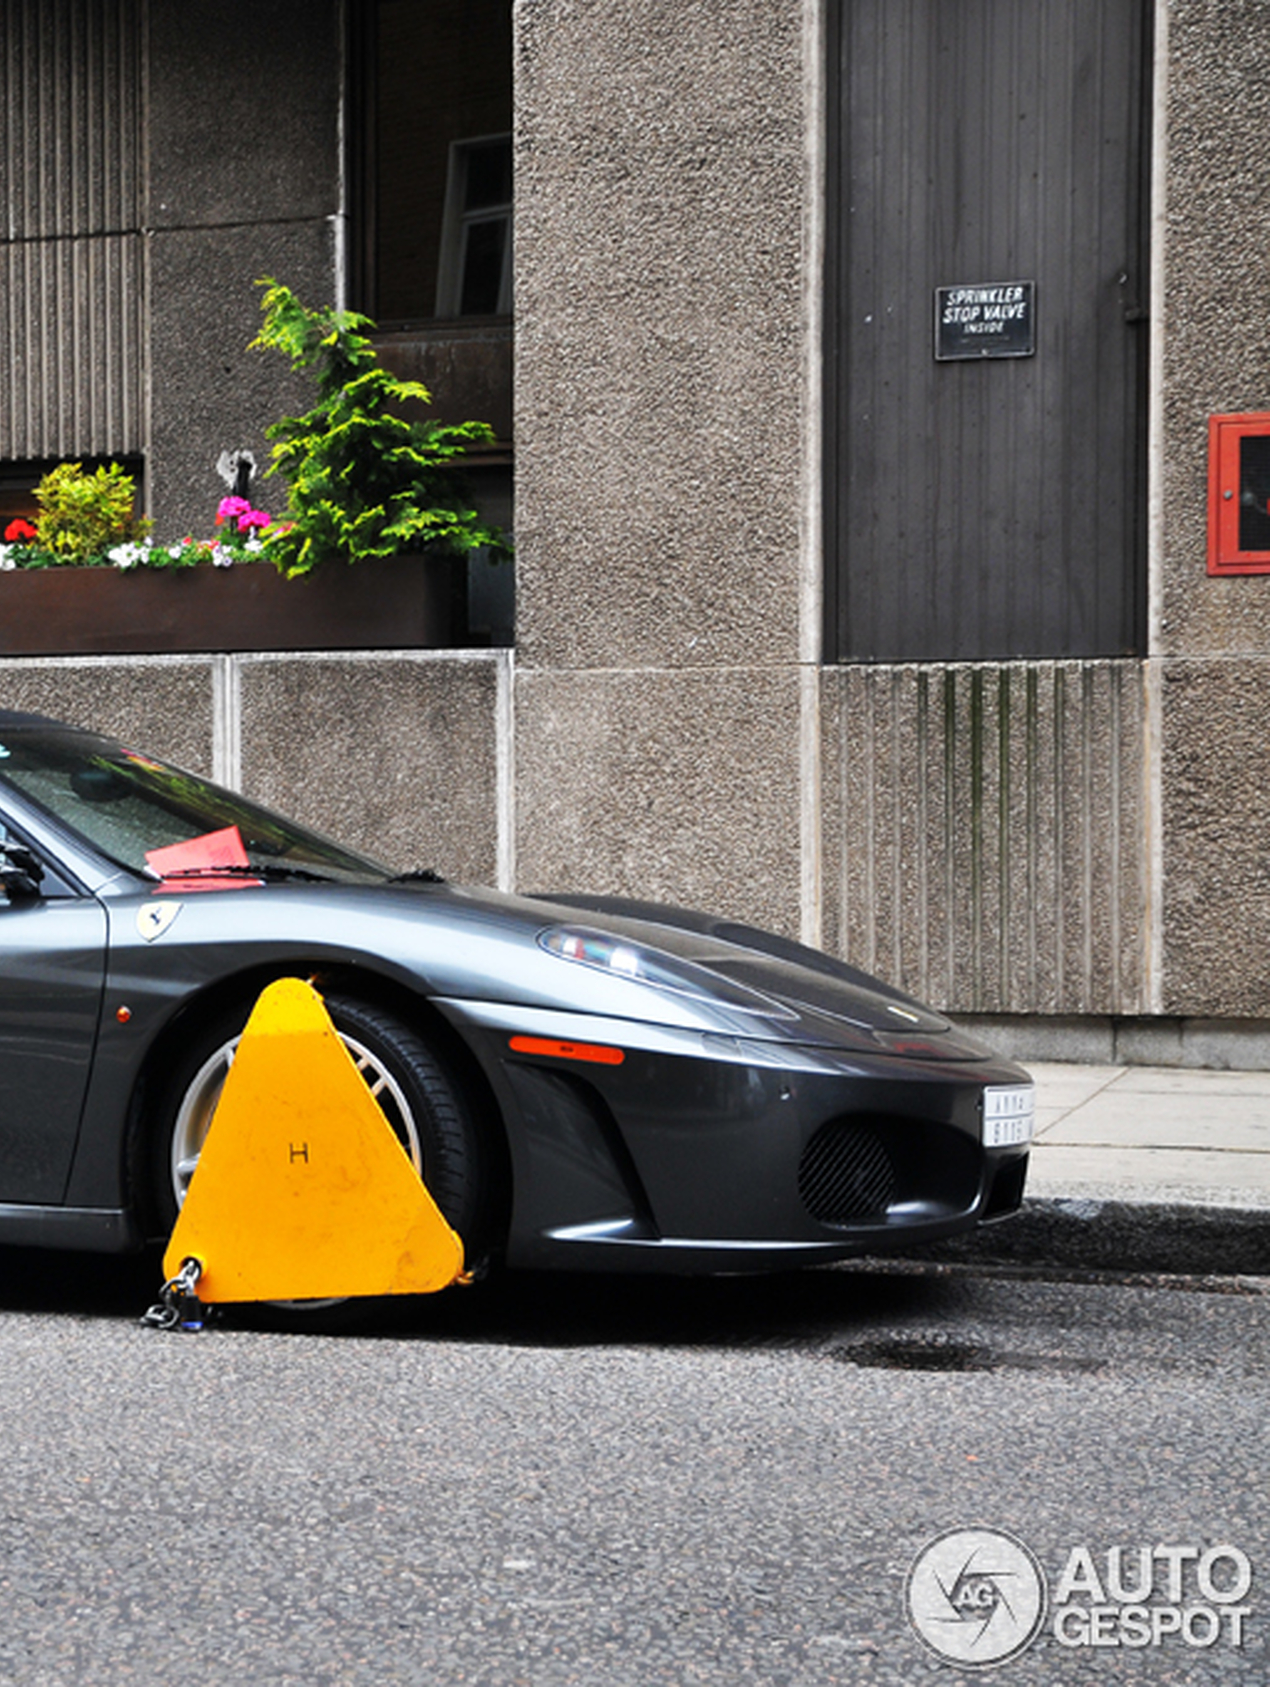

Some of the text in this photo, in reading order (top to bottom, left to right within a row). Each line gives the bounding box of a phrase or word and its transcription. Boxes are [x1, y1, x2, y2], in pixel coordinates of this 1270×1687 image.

[947, 286, 1023, 305] SPRINKLER
[942, 302, 1026, 323] STOP VALVE
[963, 321, 1004, 333] INSIDE
[289, 1142, 309, 1164] H
